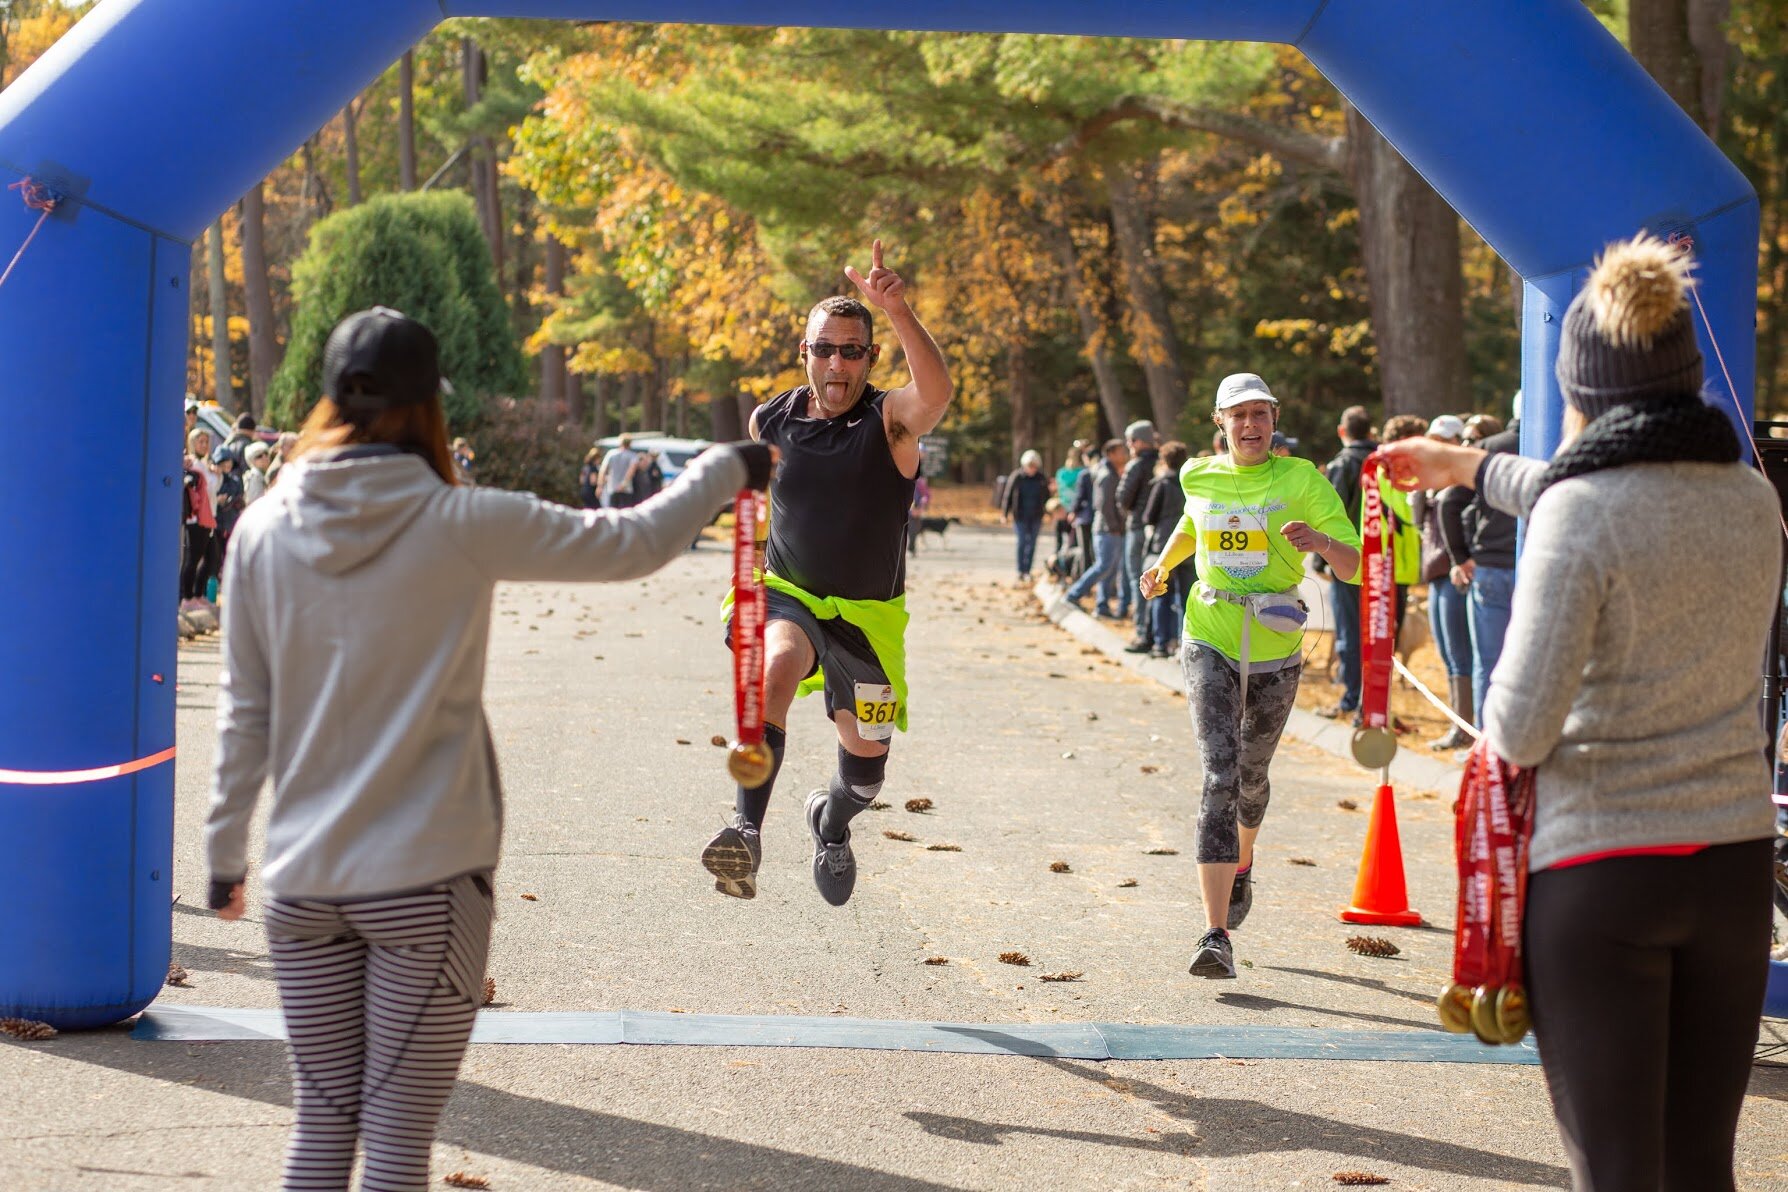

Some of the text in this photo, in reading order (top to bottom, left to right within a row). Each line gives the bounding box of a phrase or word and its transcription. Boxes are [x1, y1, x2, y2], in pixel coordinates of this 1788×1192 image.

[1258, 503, 1287, 514] CLASSIC
[1362, 472, 1382, 537] 2019
[1219, 531, 1249, 551] 89
[859, 701, 897, 723] 361
[1489, 784, 1510, 835] VALLEY
[1496, 846, 1517, 895] HAPPY
[1500, 897, 1519, 946] VALLEY
